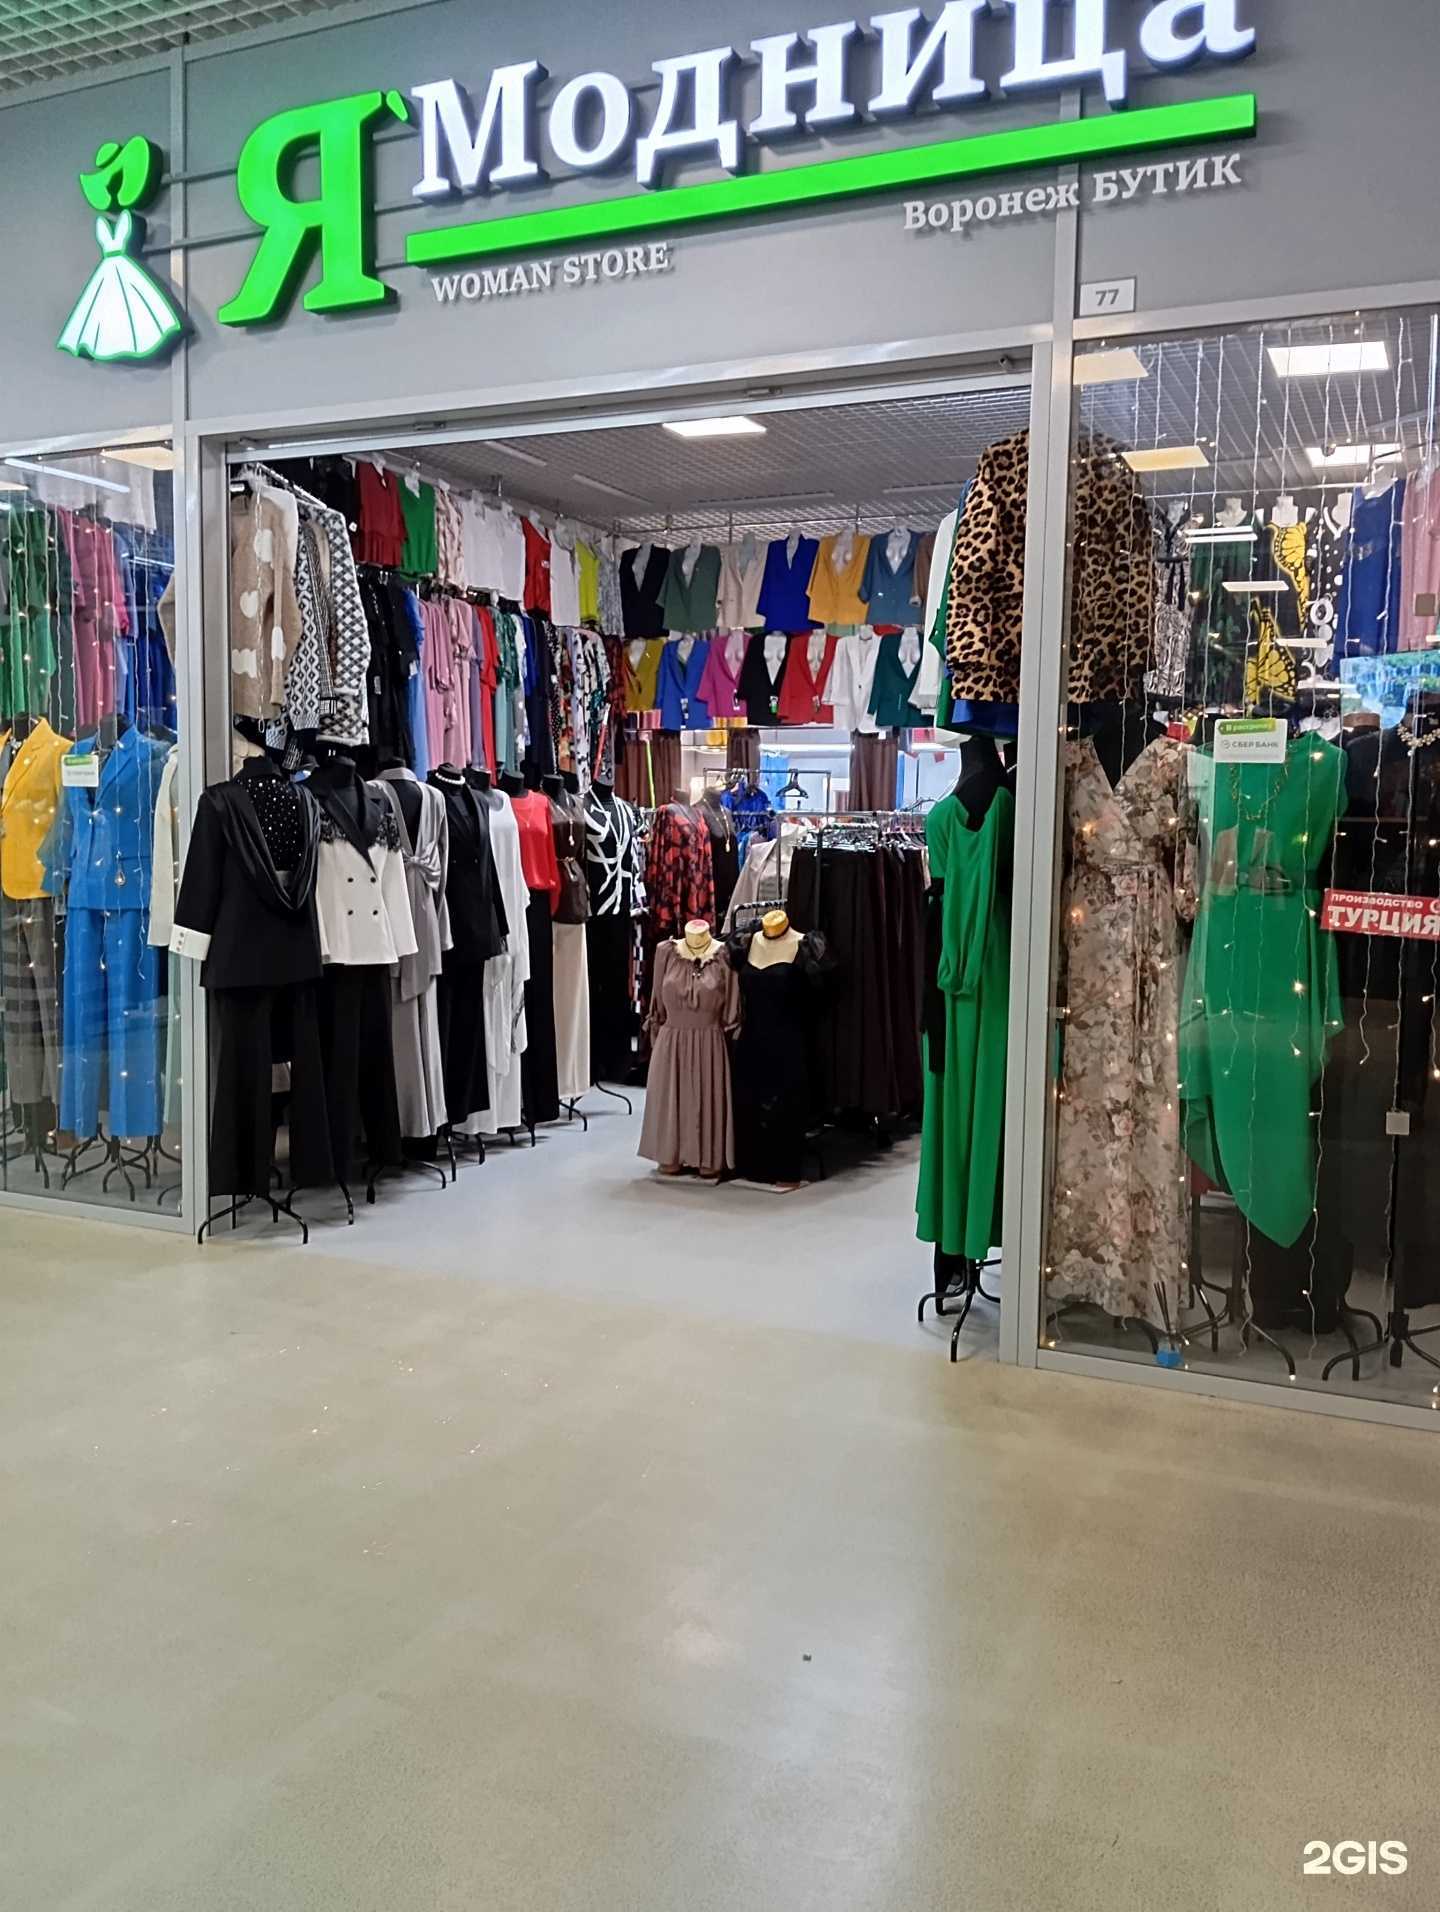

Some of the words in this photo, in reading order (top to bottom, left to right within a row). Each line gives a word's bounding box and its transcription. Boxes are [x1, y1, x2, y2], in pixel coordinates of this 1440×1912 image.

[903, 182, 1080, 232] Воронеж
[1092, 152, 1242, 203] БУТИК
[431, 260, 553, 302] WOMAN
[562, 241, 669, 283] STORE
[1094, 288, 1120, 307] 77
[1331, 893, 1424, 909] ПРОИЗВОДСТВО
[1327, 905, 1440, 936] ТУРЦИЯ
